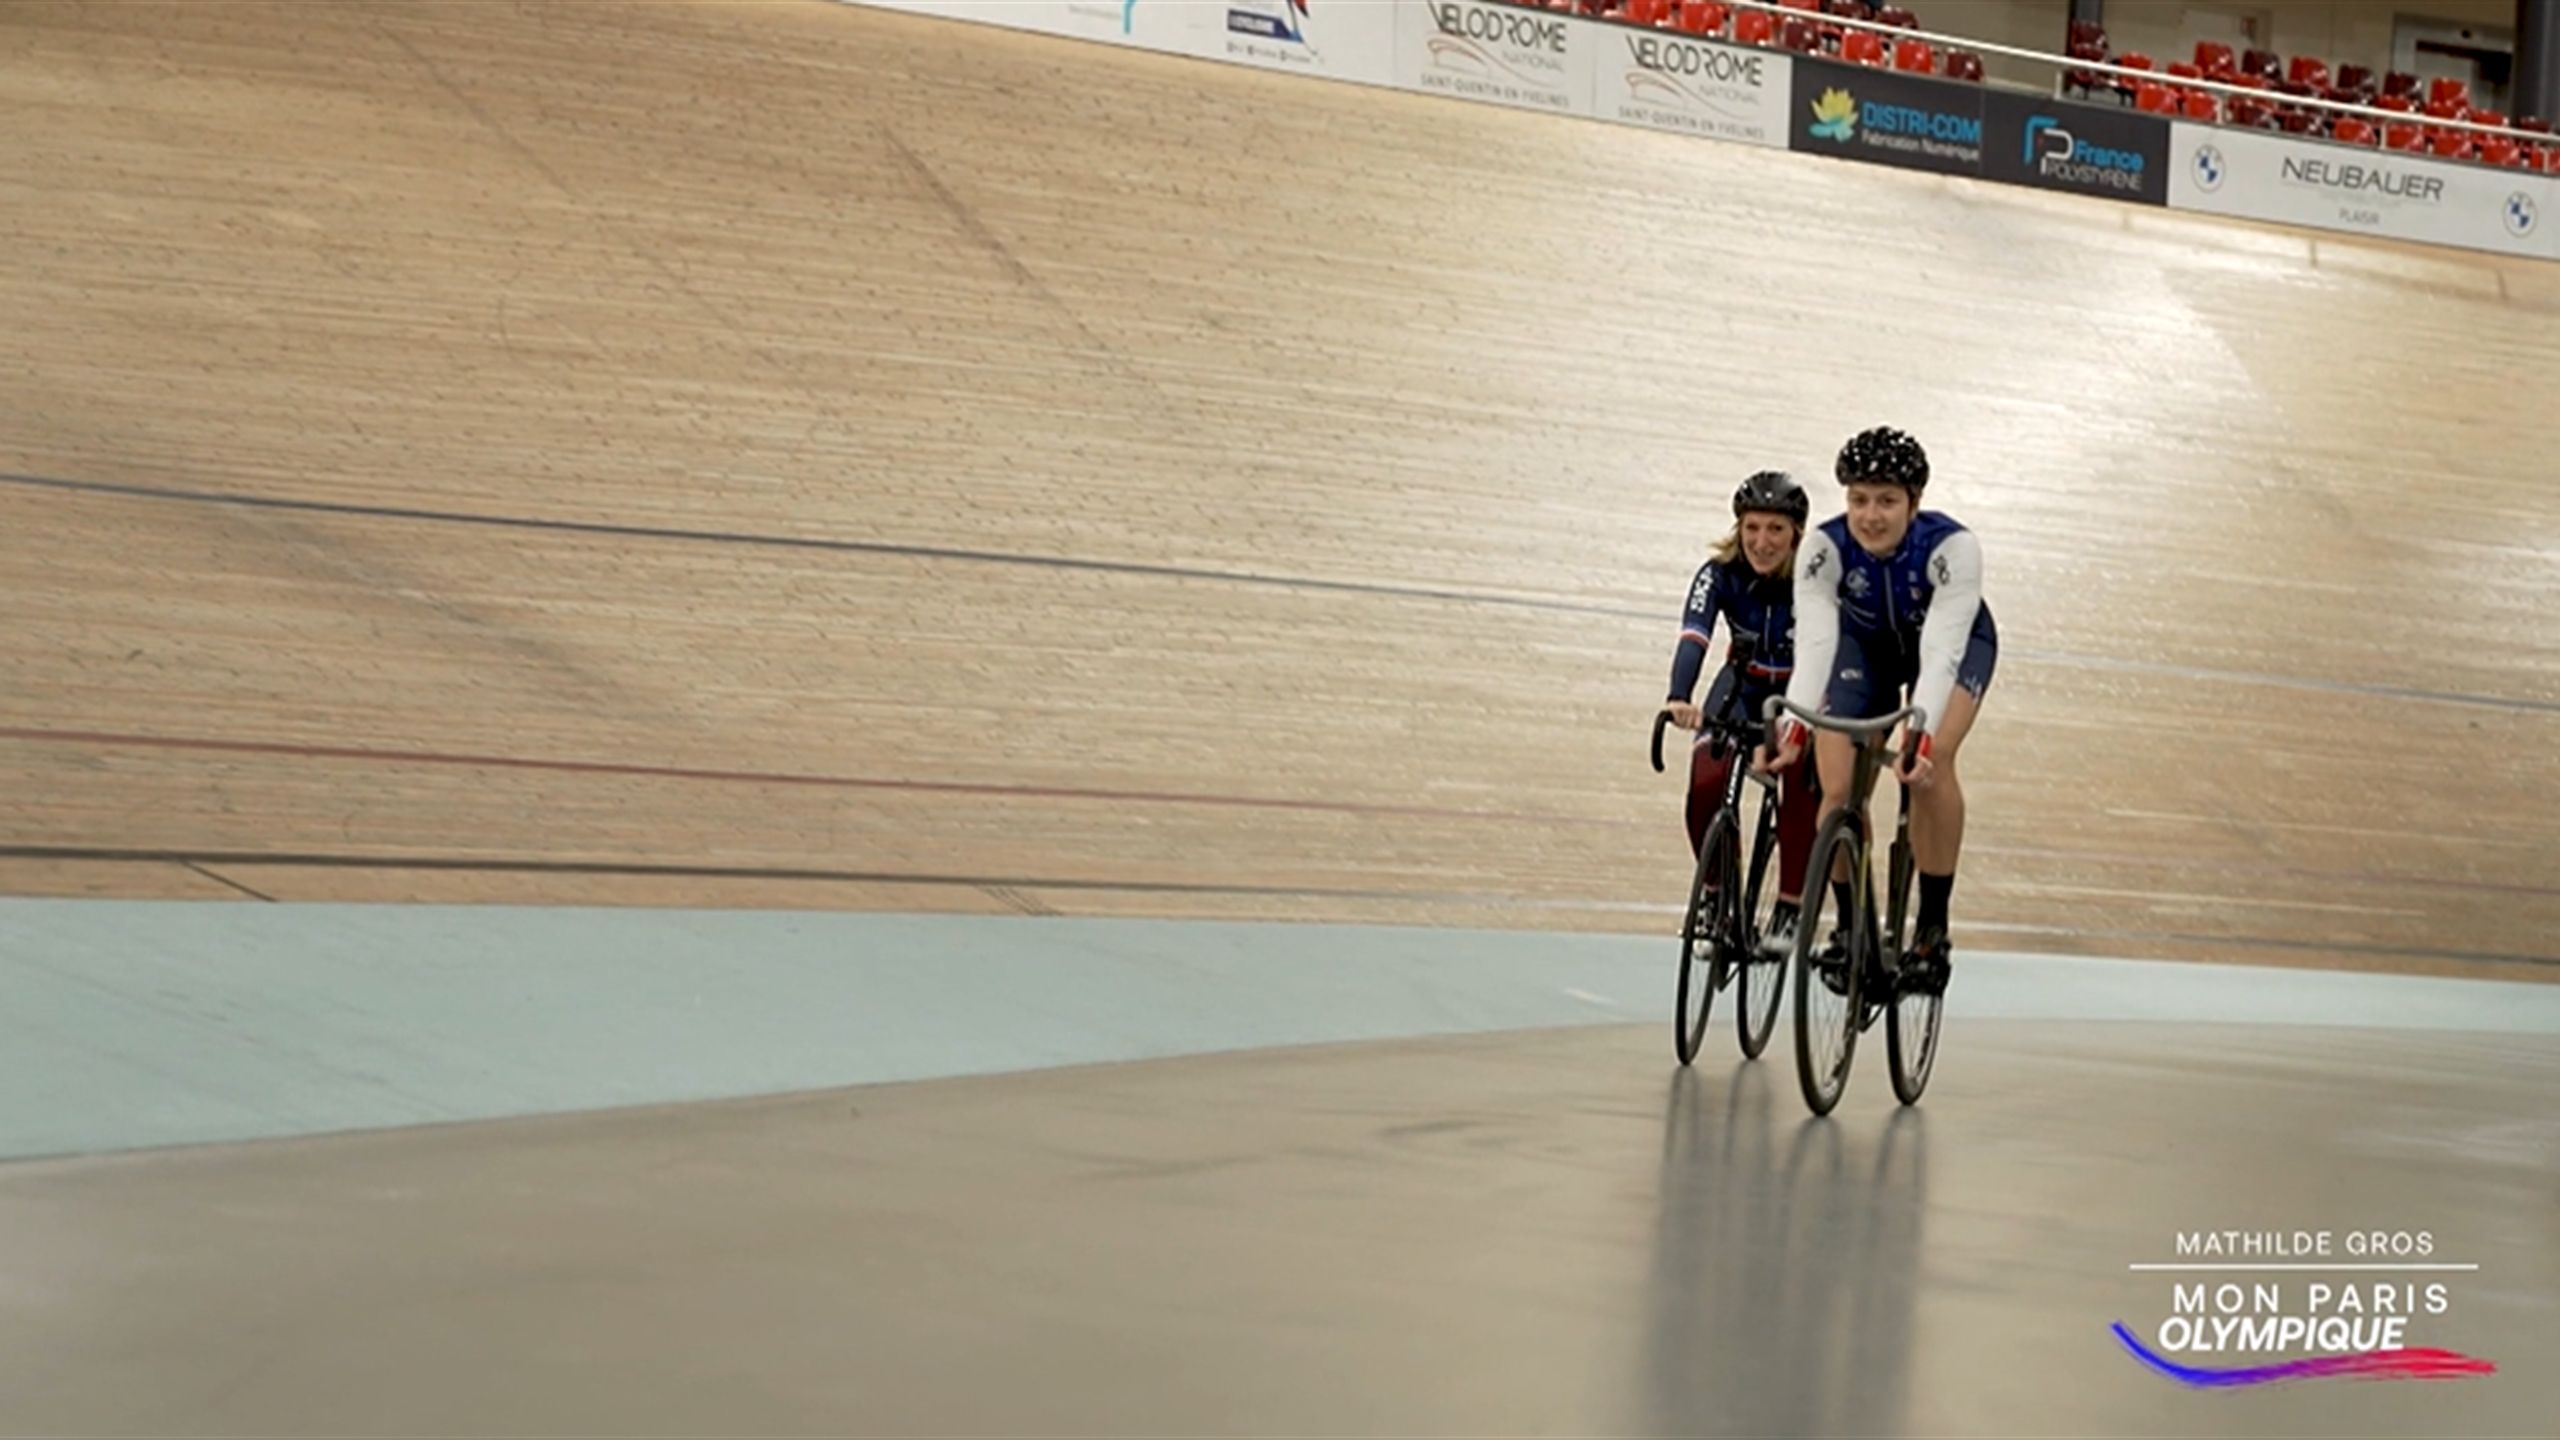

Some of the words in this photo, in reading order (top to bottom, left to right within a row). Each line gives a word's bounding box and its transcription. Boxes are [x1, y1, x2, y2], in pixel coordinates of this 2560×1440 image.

[1861, 128, 1919, 152] Fabrication
[1862, 101, 1981, 143] DISTRI-COM
[2075, 139, 2144, 173] France
[2281, 156, 2444, 202] NEUBAUER
